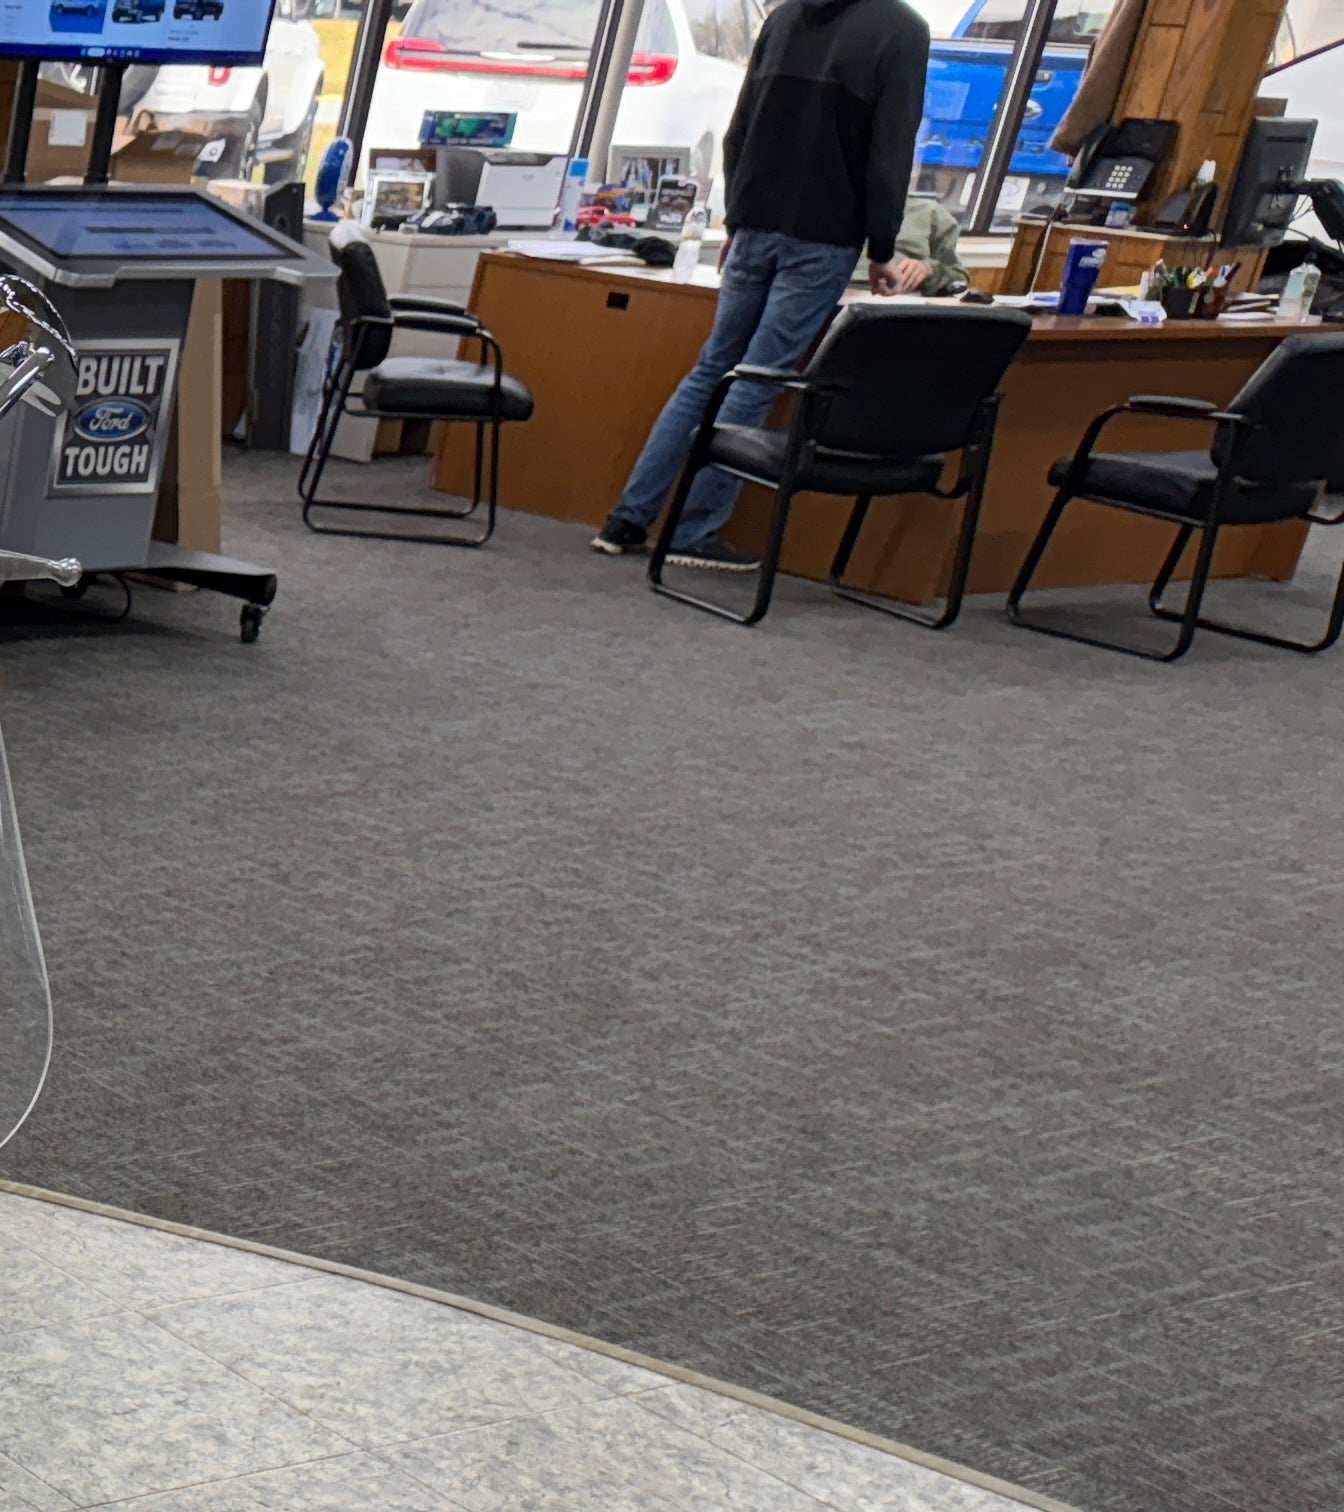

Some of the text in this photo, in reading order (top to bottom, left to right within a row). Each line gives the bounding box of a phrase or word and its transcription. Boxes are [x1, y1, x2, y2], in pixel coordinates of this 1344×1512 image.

[76, 355, 165, 396] BUILT
[88, 407, 134, 431] Ford
[64, 444, 149, 477] TOUGH
